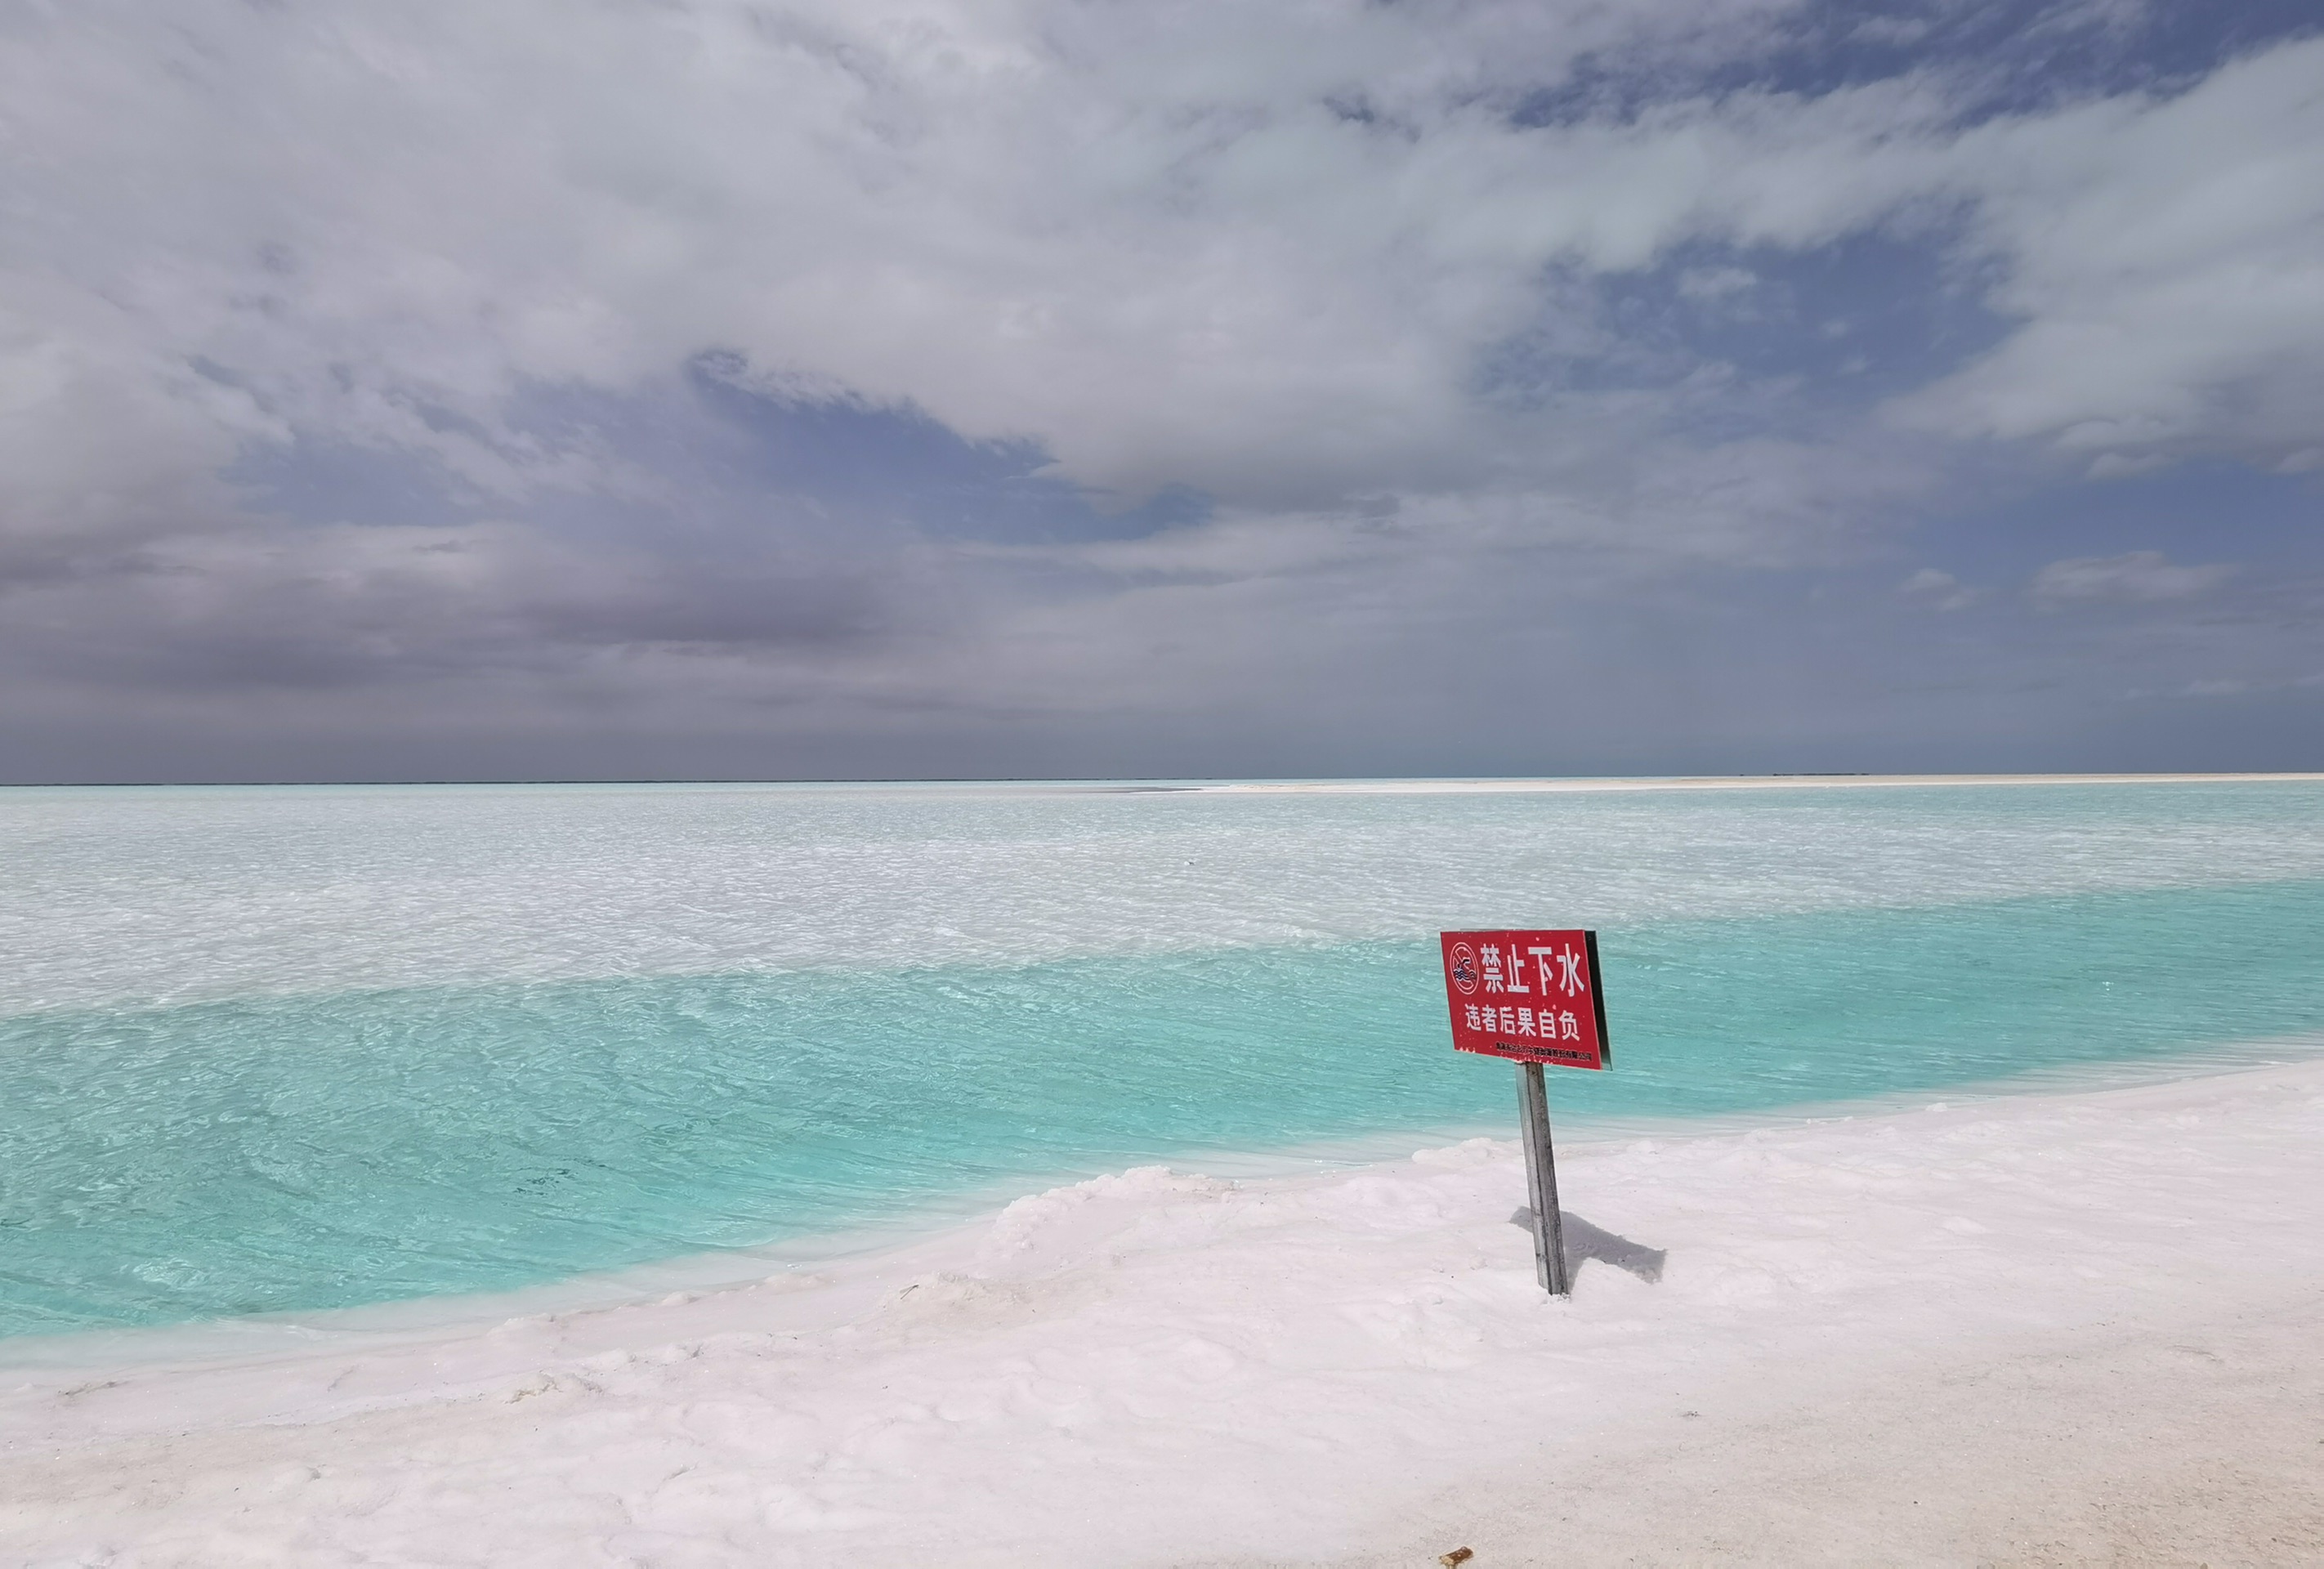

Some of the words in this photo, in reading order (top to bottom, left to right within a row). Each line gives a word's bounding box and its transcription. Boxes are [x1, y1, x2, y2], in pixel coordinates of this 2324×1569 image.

[1480, 943, 1585, 997] 禁止下水
[1464, 1004, 1580, 1041] 违者后果自负
